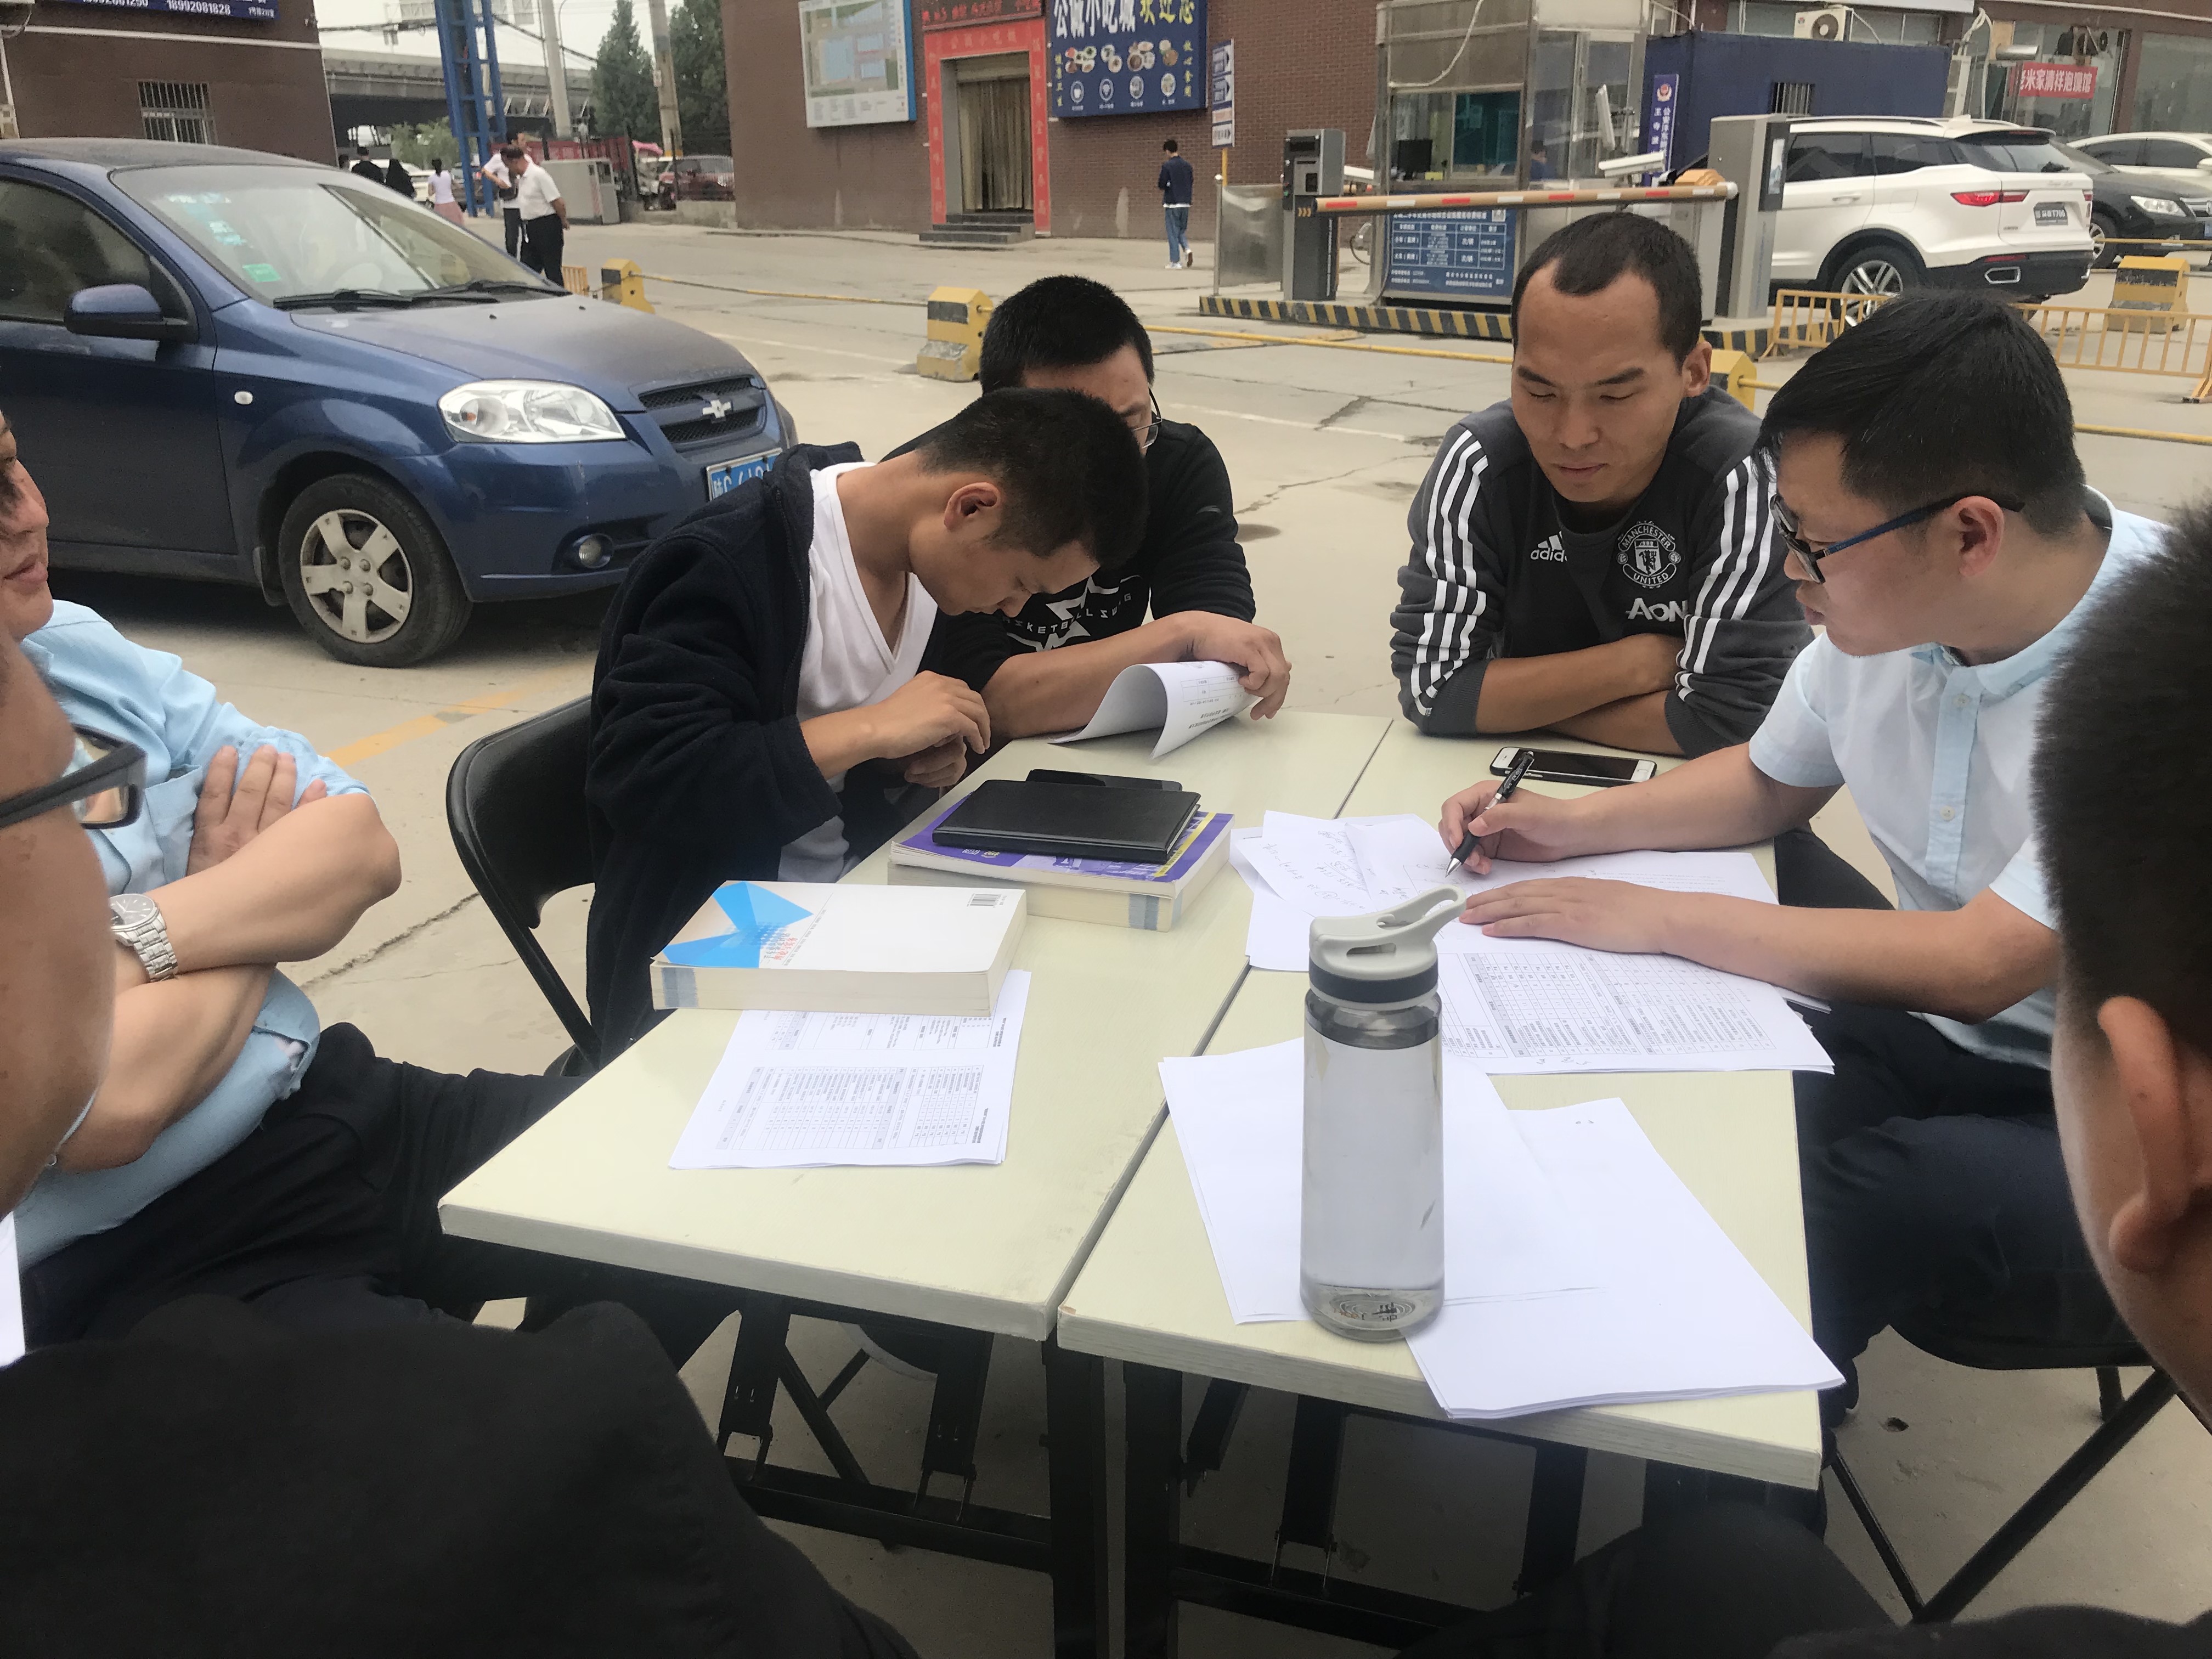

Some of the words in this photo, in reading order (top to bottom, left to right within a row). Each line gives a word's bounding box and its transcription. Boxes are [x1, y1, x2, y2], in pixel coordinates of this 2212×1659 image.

[1622, 526, 1671, 549] MANCHESTER
[1530, 548, 1567, 562] adid
[1633, 572, 1669, 585] UNITED
